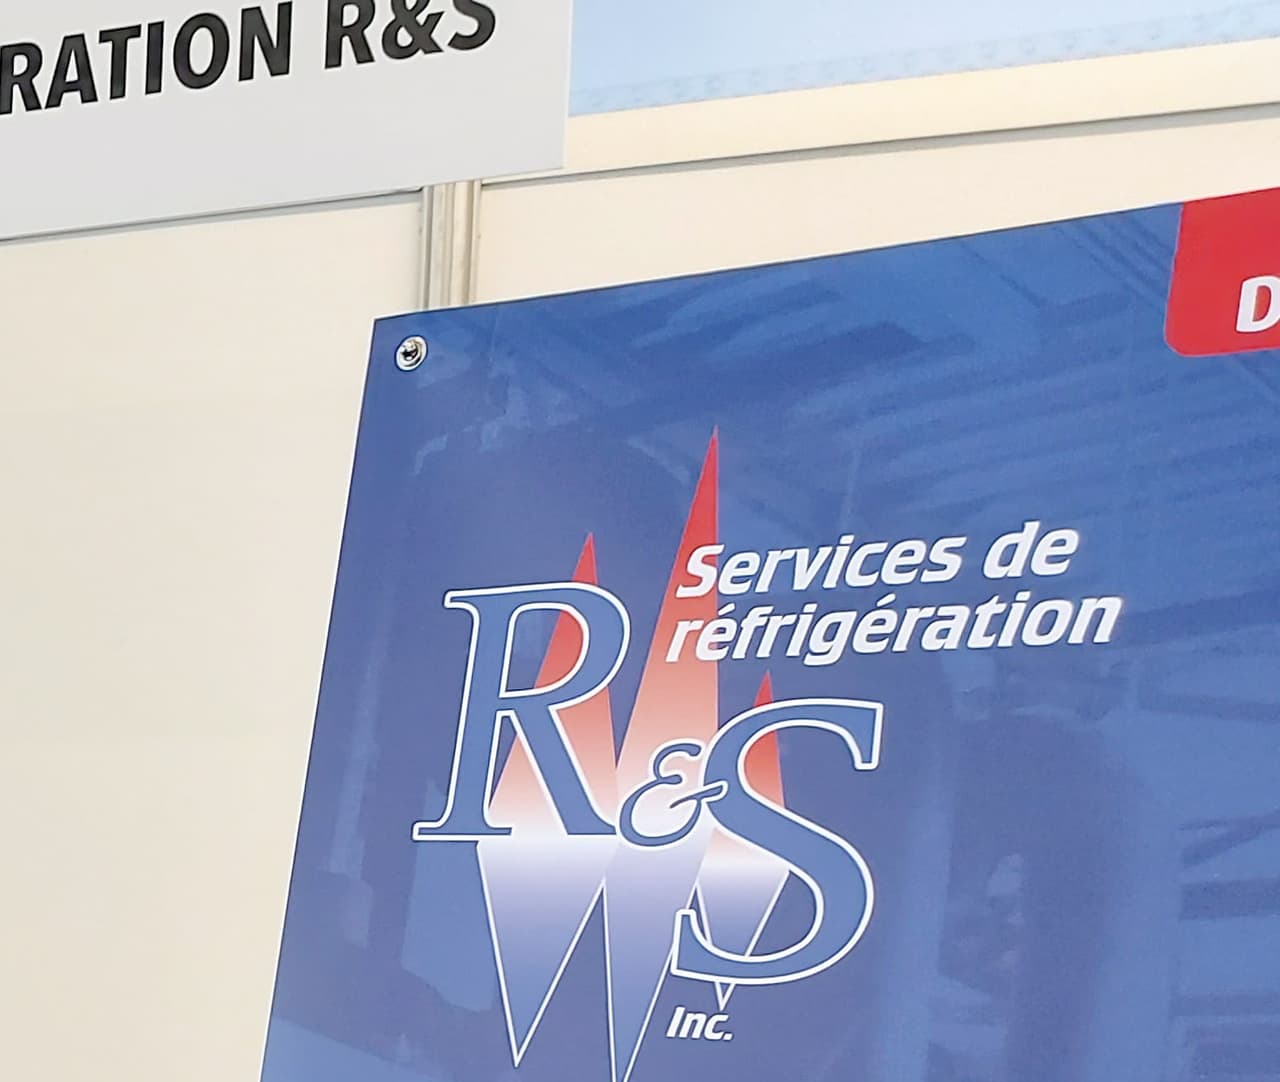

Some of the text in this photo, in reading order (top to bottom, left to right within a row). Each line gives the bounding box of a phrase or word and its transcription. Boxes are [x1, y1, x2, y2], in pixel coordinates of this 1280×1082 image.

[324, 0, 496, 69] R&S
[674, 521, 1080, 600] Services de
[663, 593, 1123, 668] réfrigération
[411, 582, 884, 986] R&S
[666, 1006, 734, 1042] Inc.
